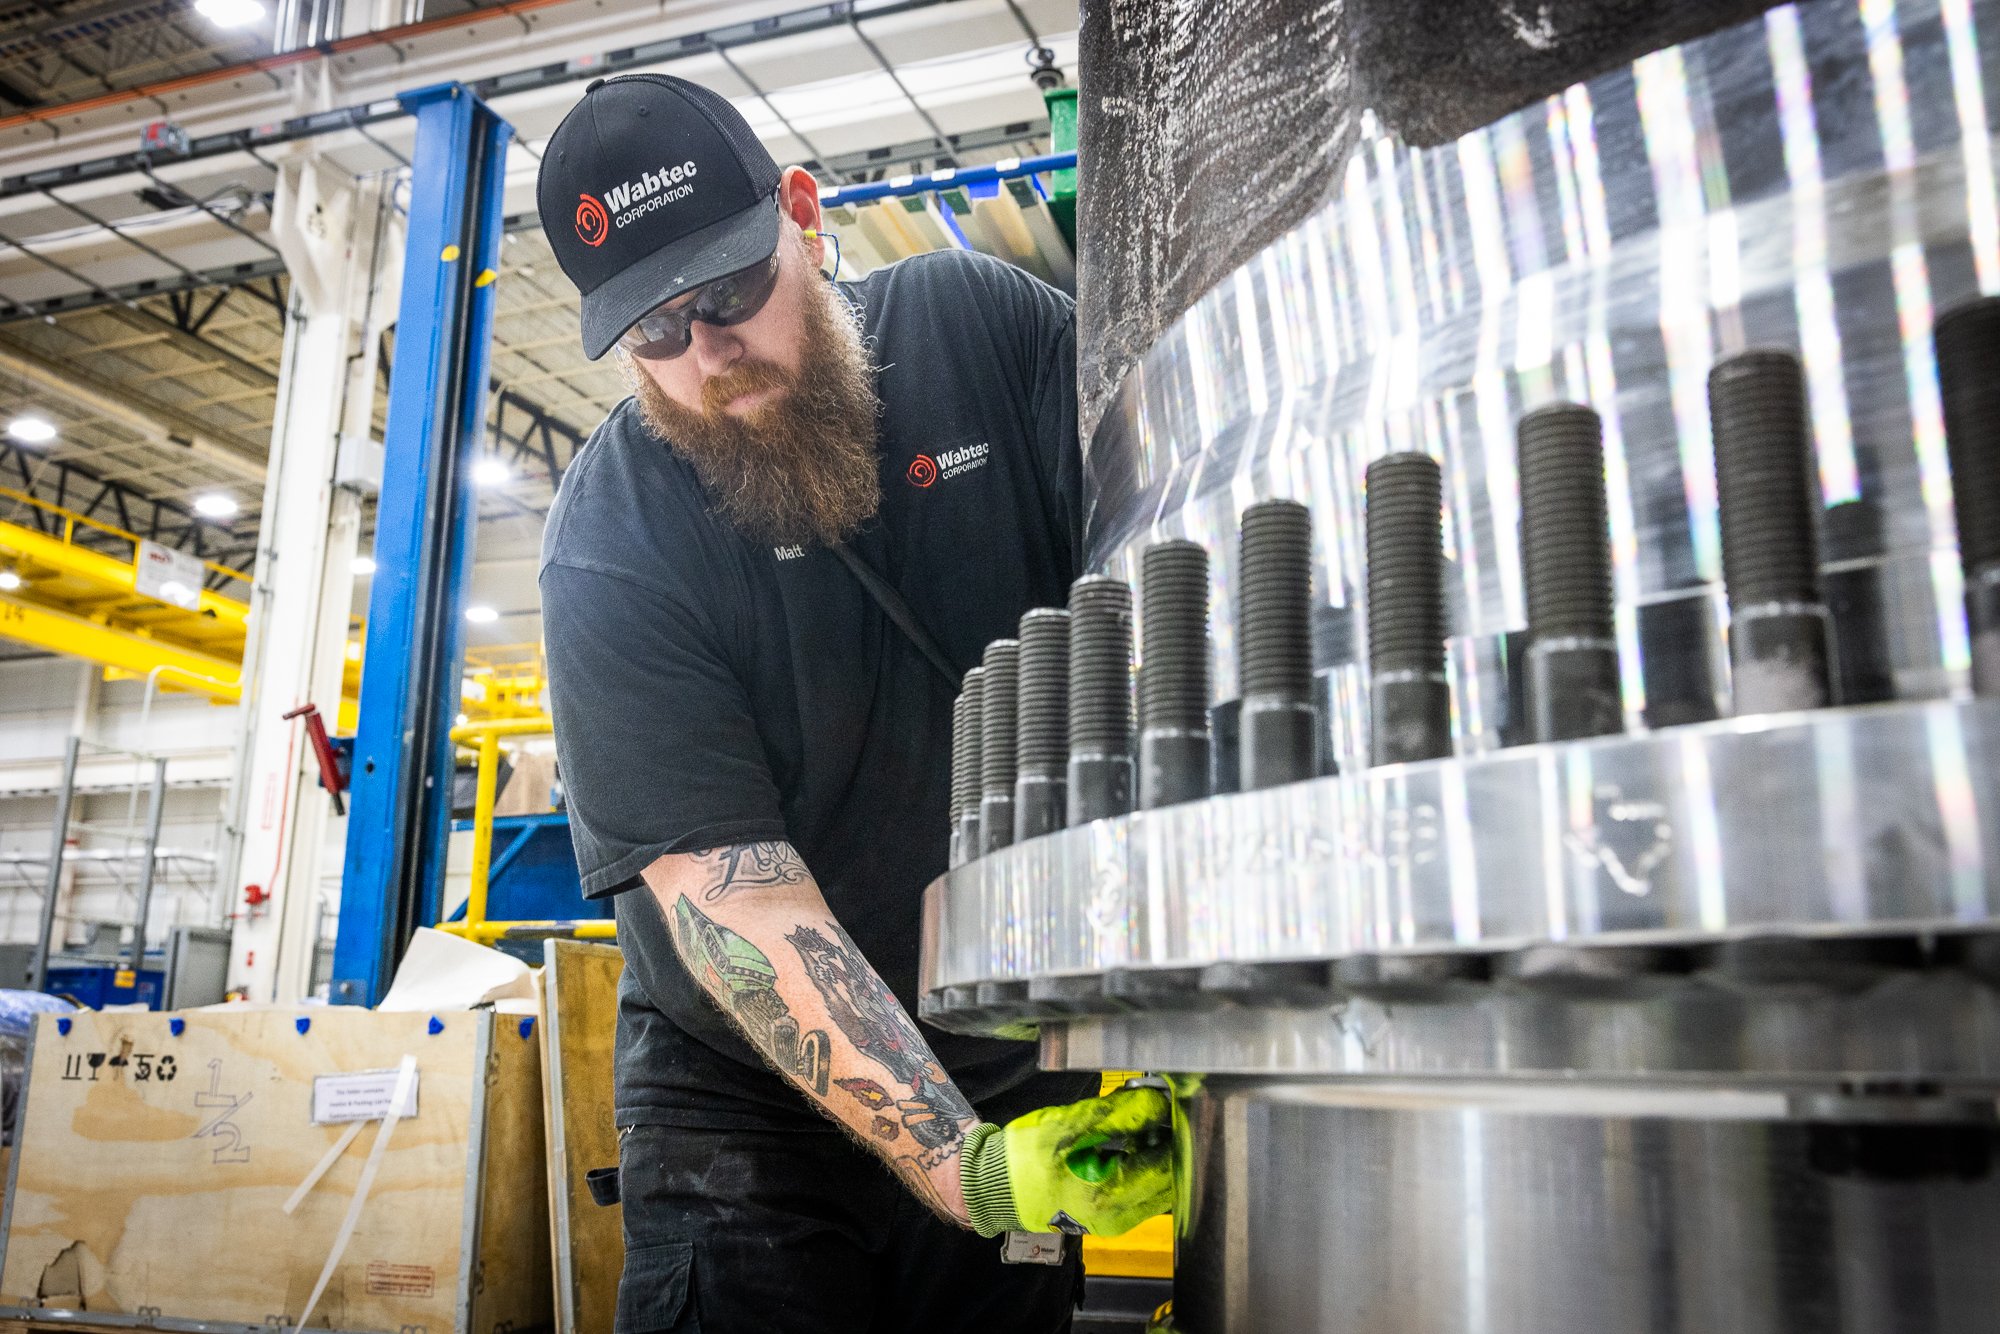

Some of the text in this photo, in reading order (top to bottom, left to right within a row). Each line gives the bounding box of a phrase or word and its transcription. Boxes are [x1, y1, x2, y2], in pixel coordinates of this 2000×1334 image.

[603, 160, 697, 214] Wabtec
[615, 183, 694, 229] CORPORATION
[936, 442, 989, 470] Wabtec
[942, 457, 988, 480] CORPORATION
[773, 543, 805, 561] Matt
